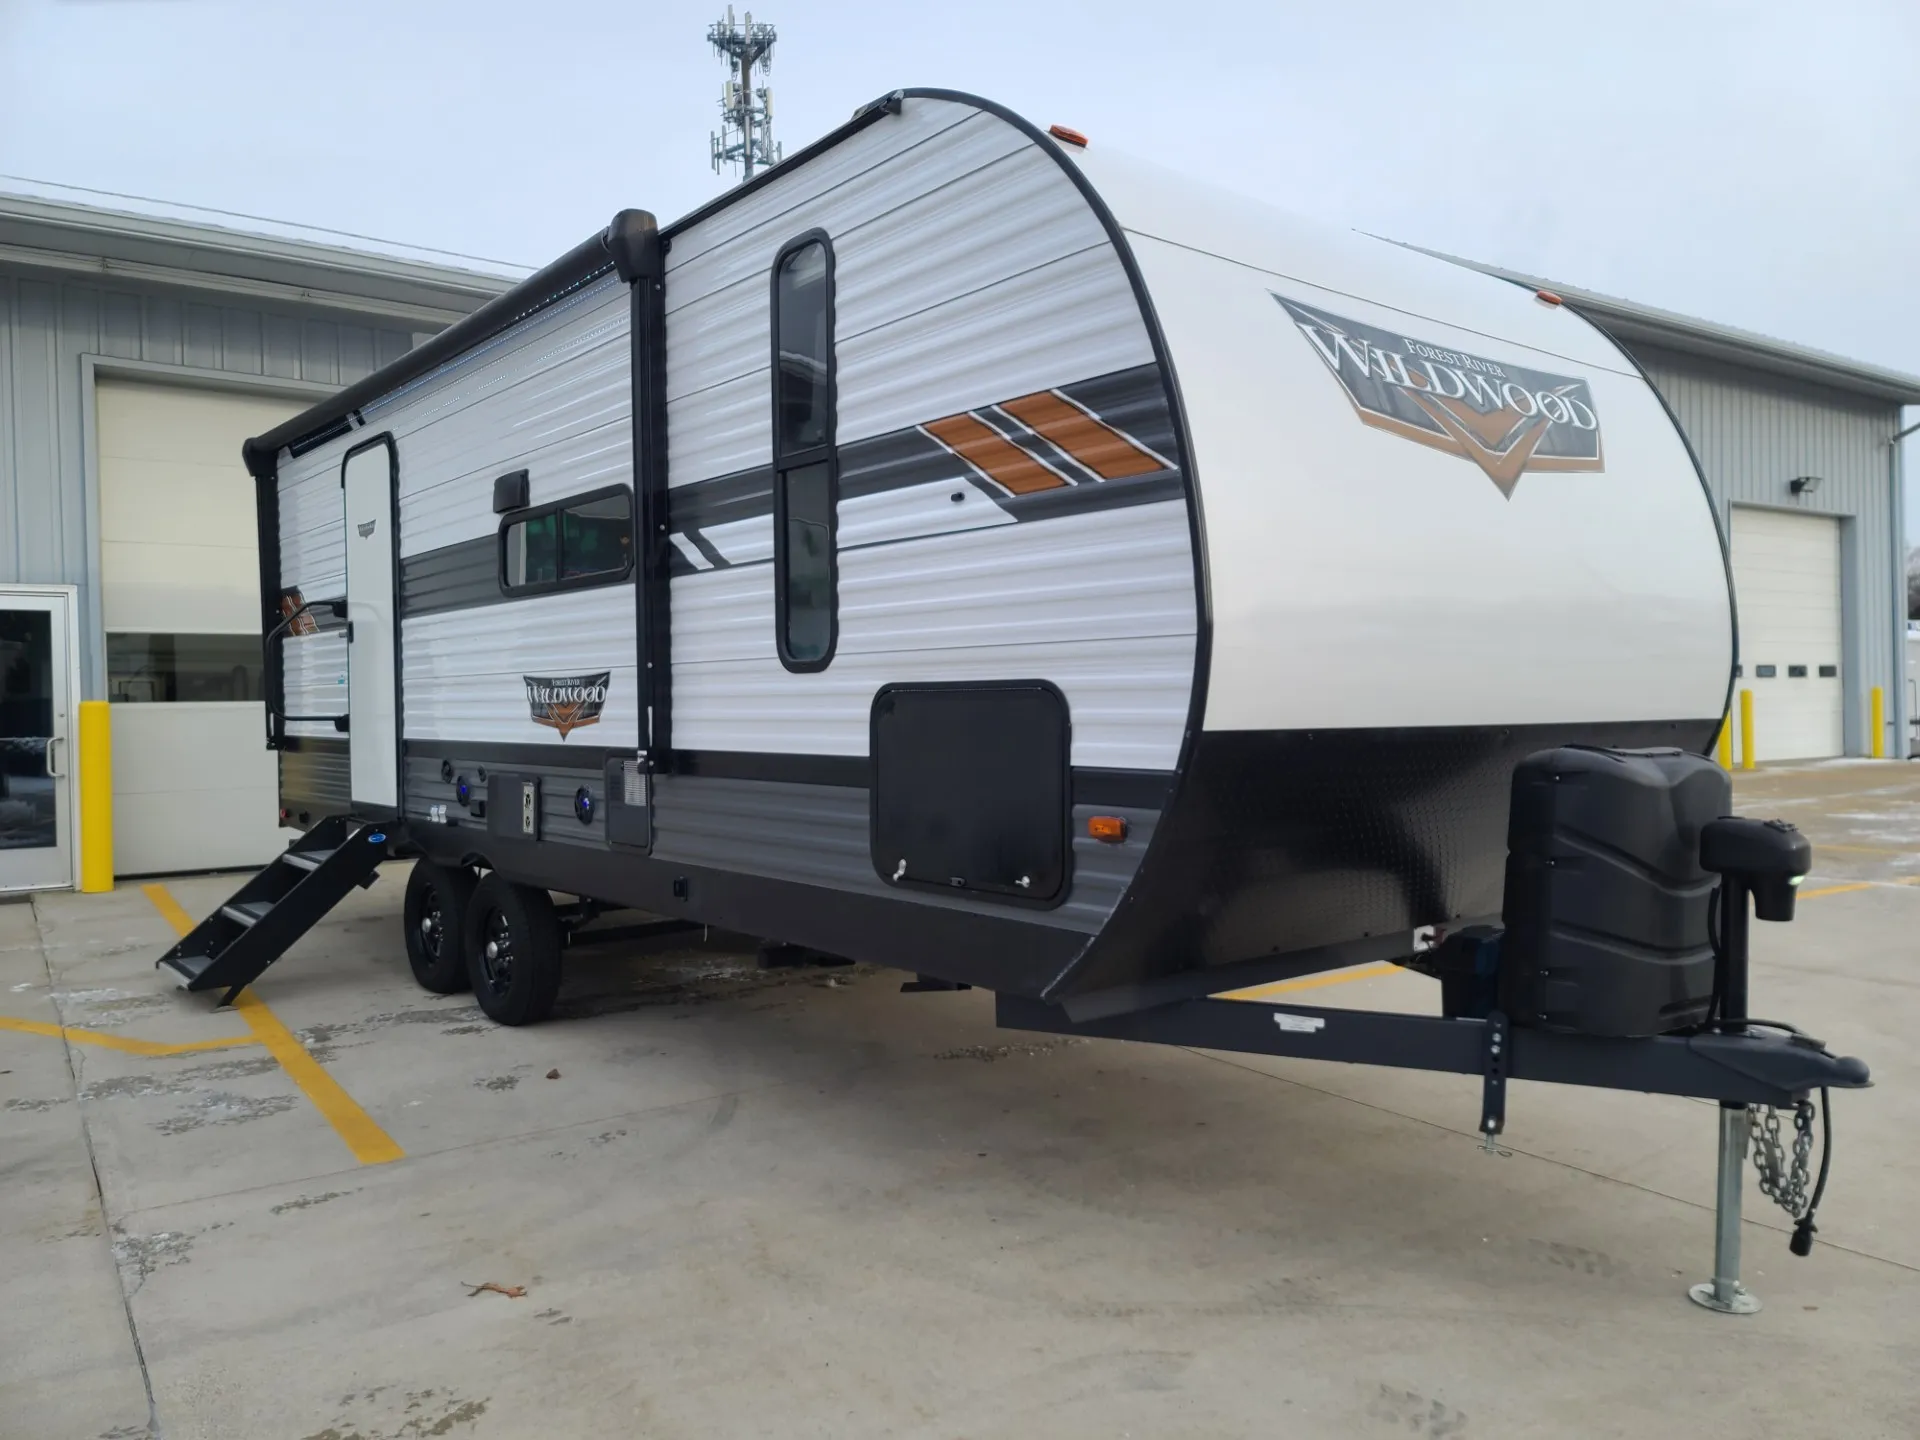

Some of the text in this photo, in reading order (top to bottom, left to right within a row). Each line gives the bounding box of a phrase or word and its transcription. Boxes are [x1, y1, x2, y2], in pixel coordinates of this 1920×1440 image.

[1296, 323, 1597, 430] WILDWOOD
[1404, 338, 1506, 377] FOREST RIVER
[527, 685, 605, 703] WILDWOOD
